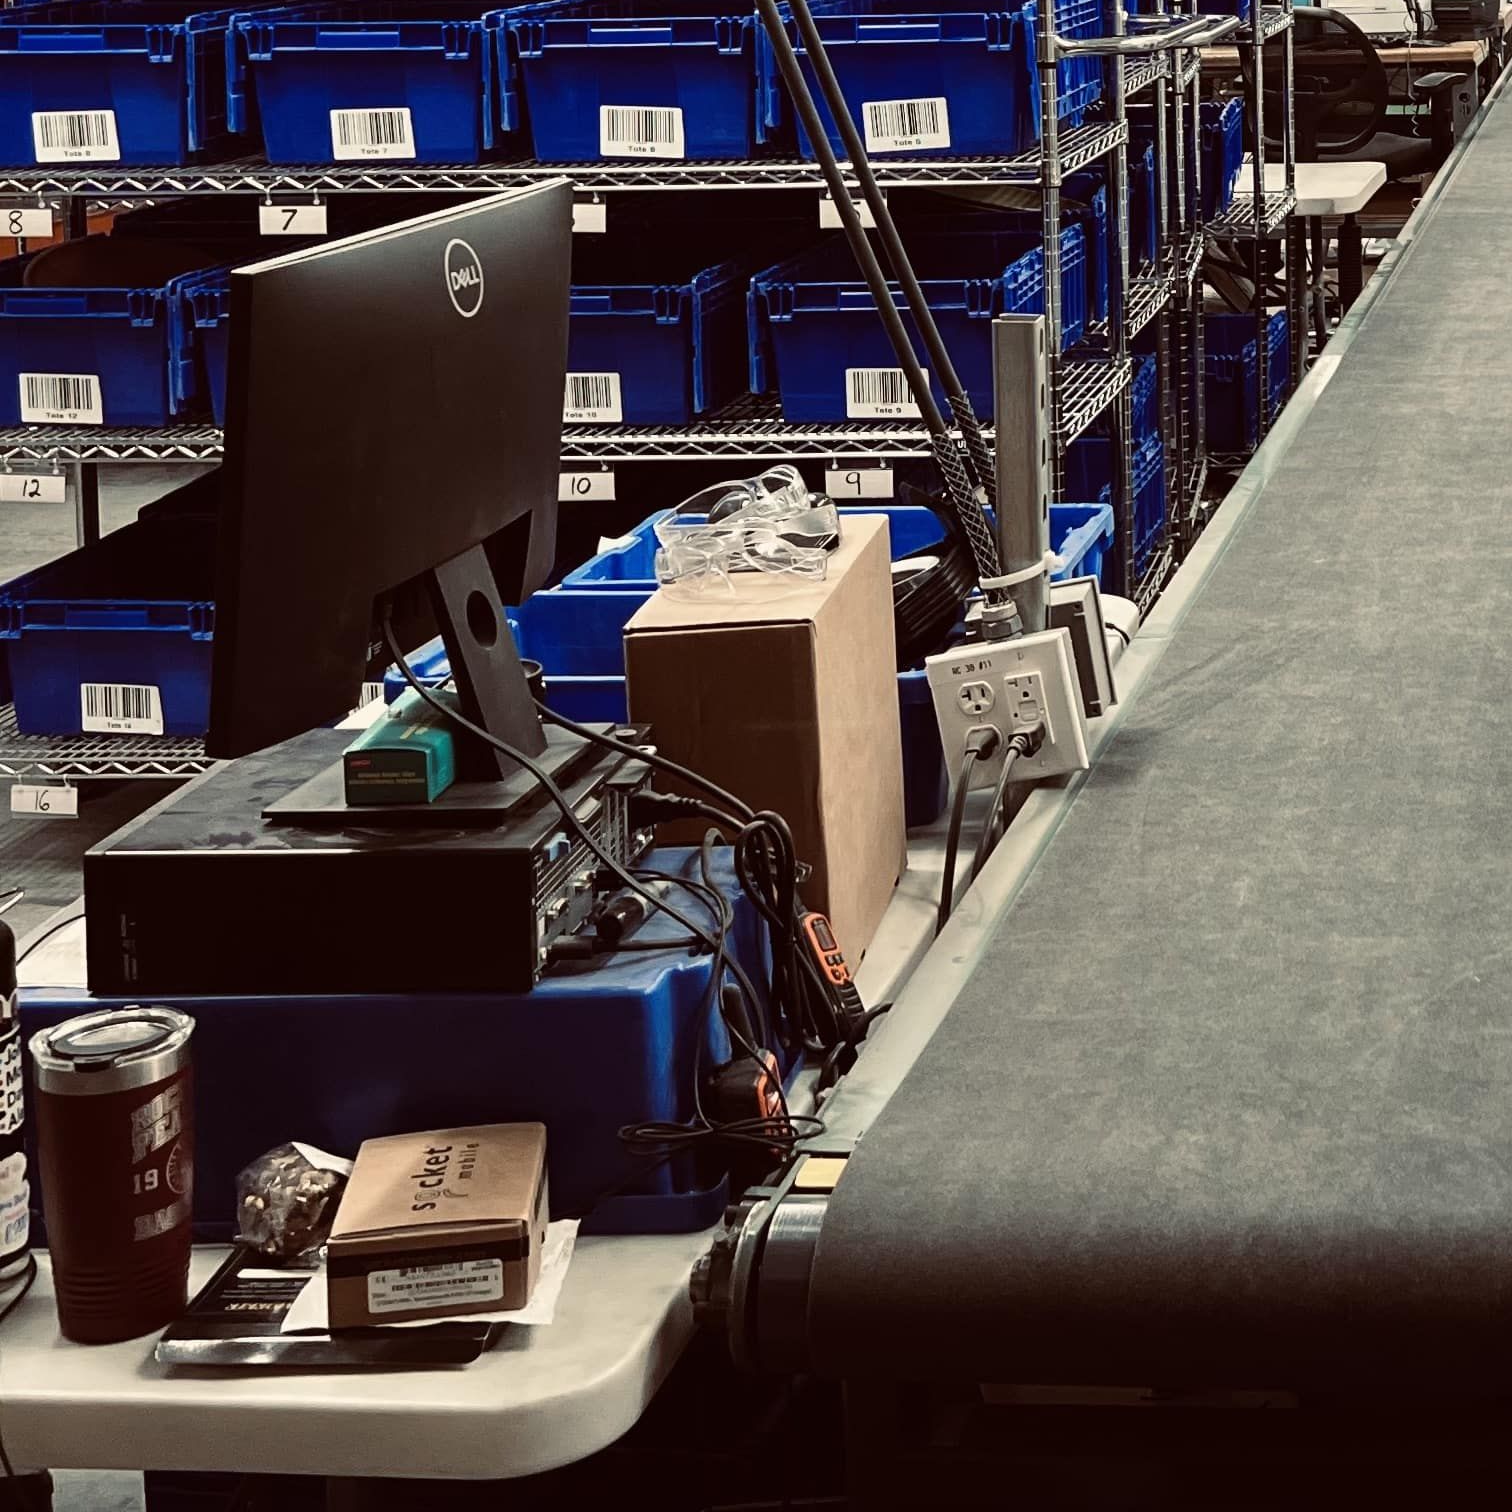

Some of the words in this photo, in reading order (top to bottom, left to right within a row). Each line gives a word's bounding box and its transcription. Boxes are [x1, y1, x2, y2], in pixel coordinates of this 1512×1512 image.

[8, 210, 24, 235] 8
[280, 209, 298, 231] 7
[451, 265, 480, 291] DELL
[22, 478, 42, 498] 12
[571, 476, 592, 496] 10
[845, 471, 861, 496] 9
[34, 789, 51, 812] 16
[458, 1143, 480, 1181] mobile
[411, 1146, 453, 1212] socket
